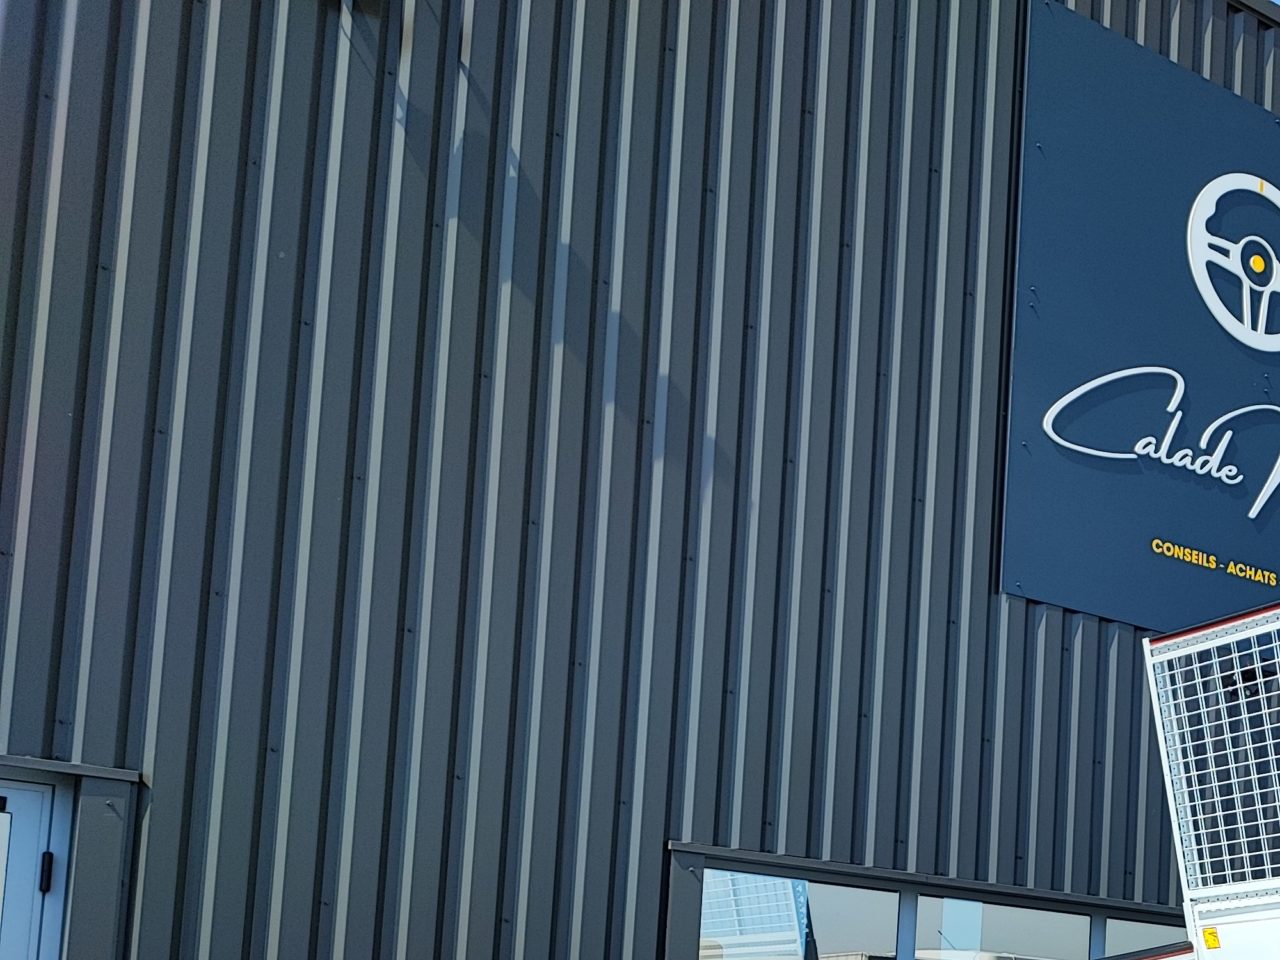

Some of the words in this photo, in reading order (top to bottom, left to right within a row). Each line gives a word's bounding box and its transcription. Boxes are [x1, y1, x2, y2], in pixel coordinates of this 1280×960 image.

[1042, 366, 1244, 485] Calade
[1151, 538, 1217, 569] CONSEILS
[1226, 560, 1277, 587] ACHATS
